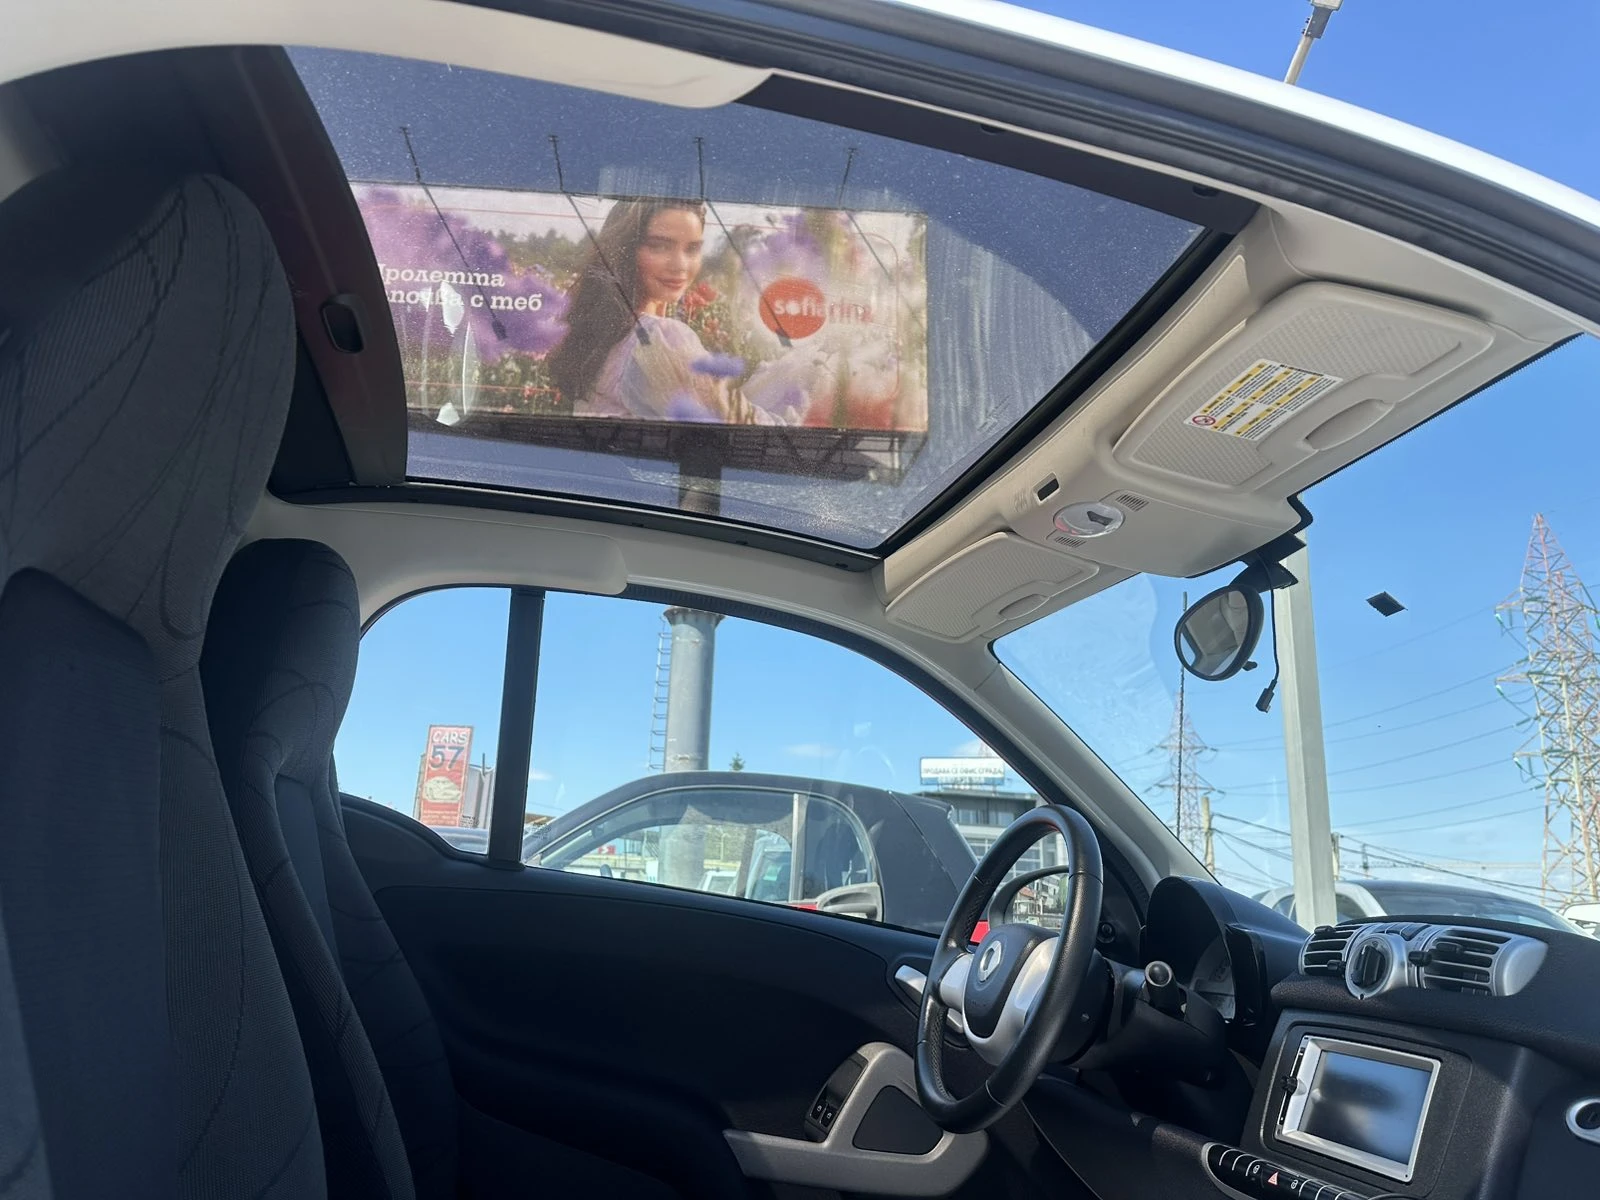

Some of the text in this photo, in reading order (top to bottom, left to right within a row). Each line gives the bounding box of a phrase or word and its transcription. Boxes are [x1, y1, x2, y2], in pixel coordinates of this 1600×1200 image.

[490, 293, 543, 311] теб
[432, 730, 468, 745] CARS
[429, 745, 465, 771] 57
